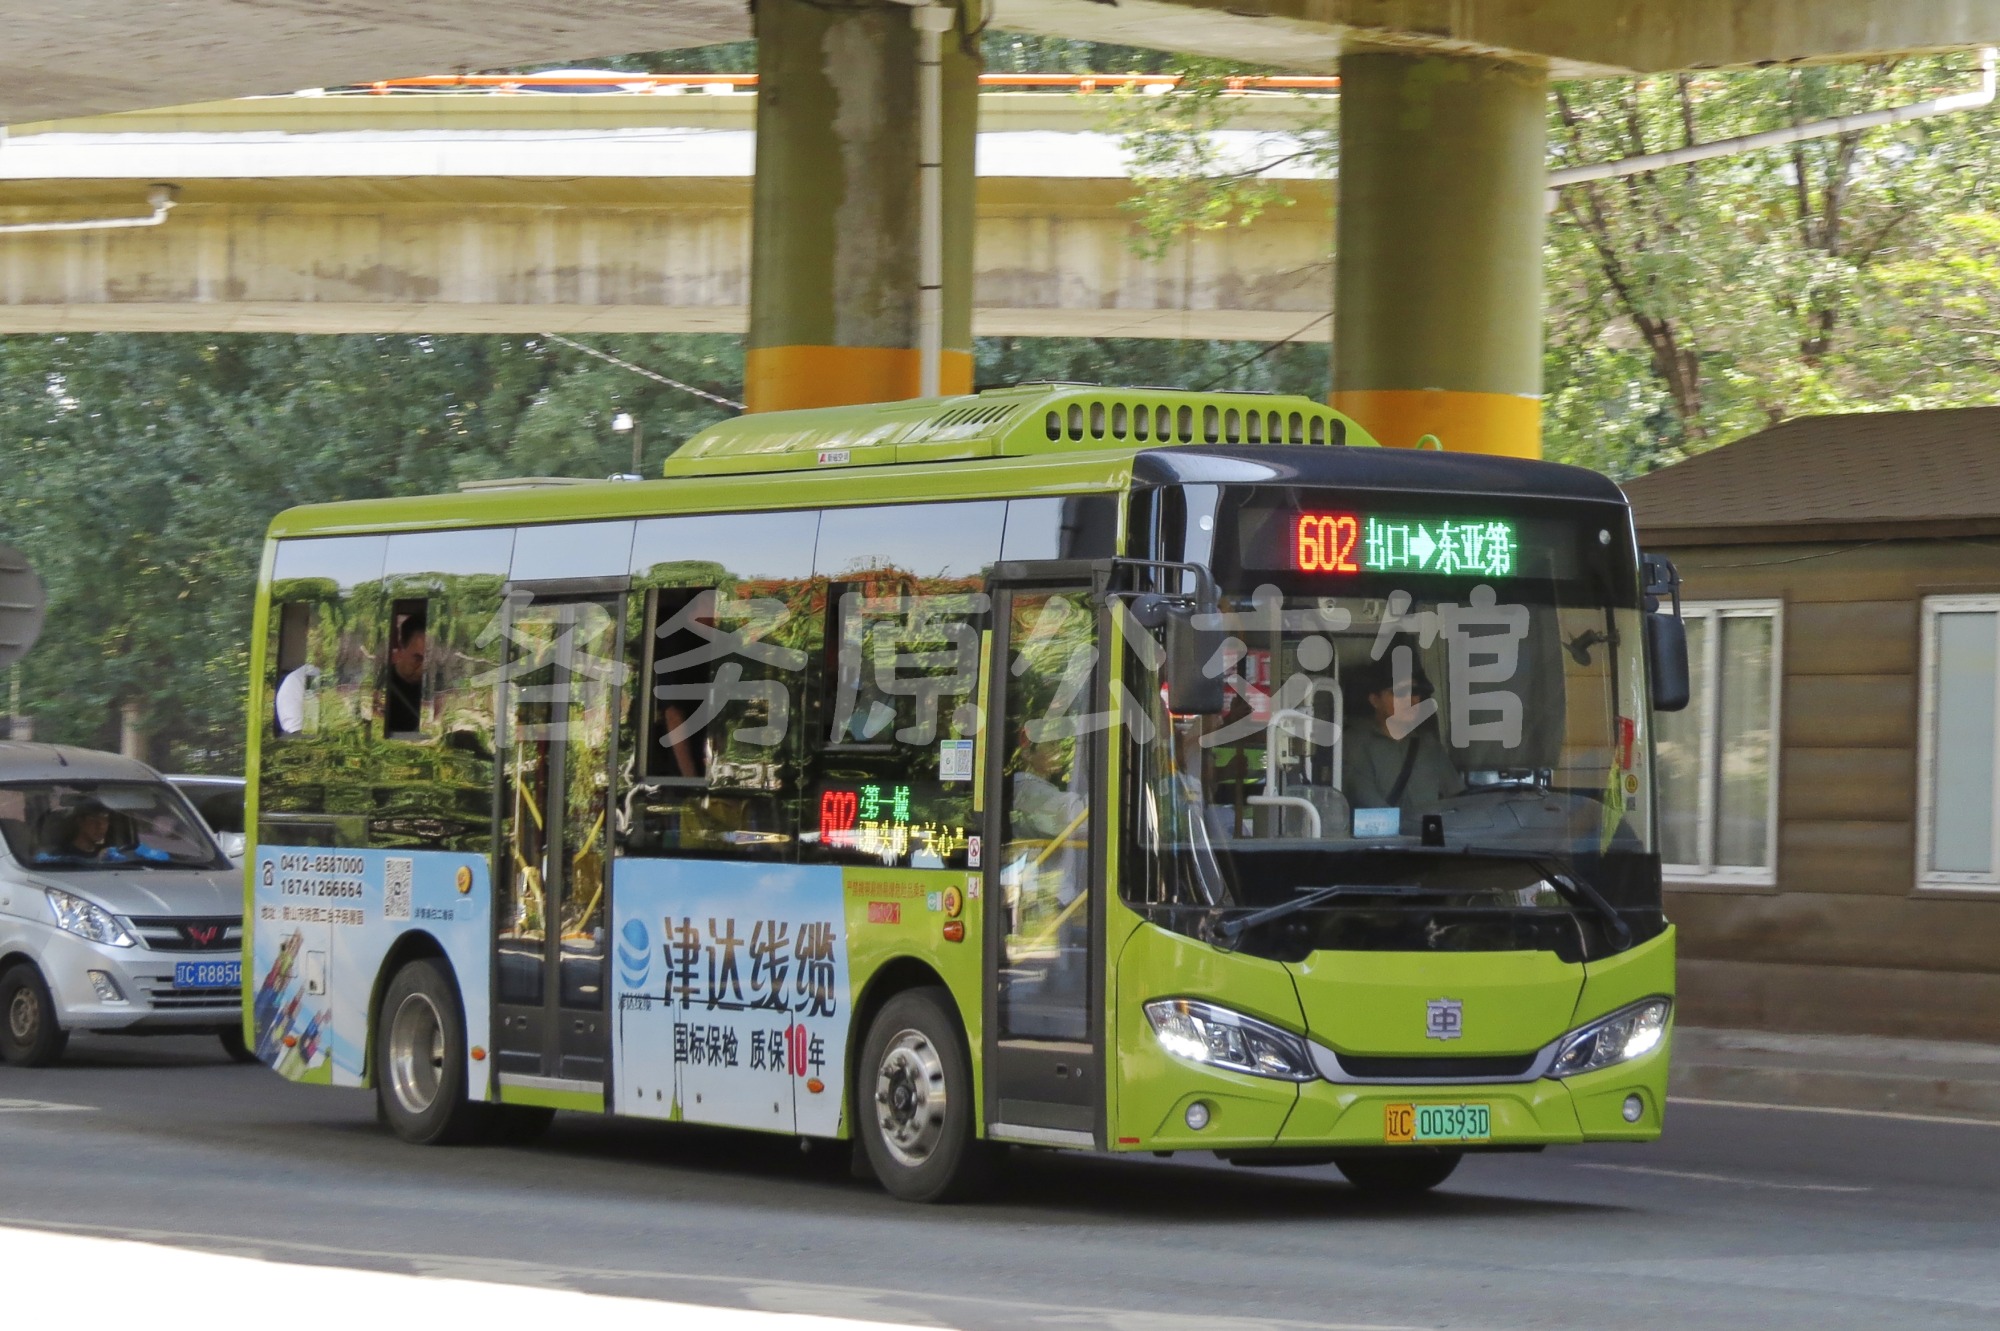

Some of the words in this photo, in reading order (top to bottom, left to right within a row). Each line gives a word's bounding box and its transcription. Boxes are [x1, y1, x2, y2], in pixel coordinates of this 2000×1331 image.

[1298, 514, 1357, 572] 602
[1366, 517, 1410, 571] 出口
[820, 791, 857, 844] 602
[280, 855, 364, 875] 0412-8587000
[280, 879, 363, 899] 18741266664
[198, 964, 243, 983] R885H
[663, 916, 837, 1018] 津达线缆
[674, 1022, 739, 1067] 国标保检
[750, 1023, 826, 1078] 质保10年
[1388, 1109, 1411, 1136] 辽C
[1420, 1109, 1488, 1136] 00393D
